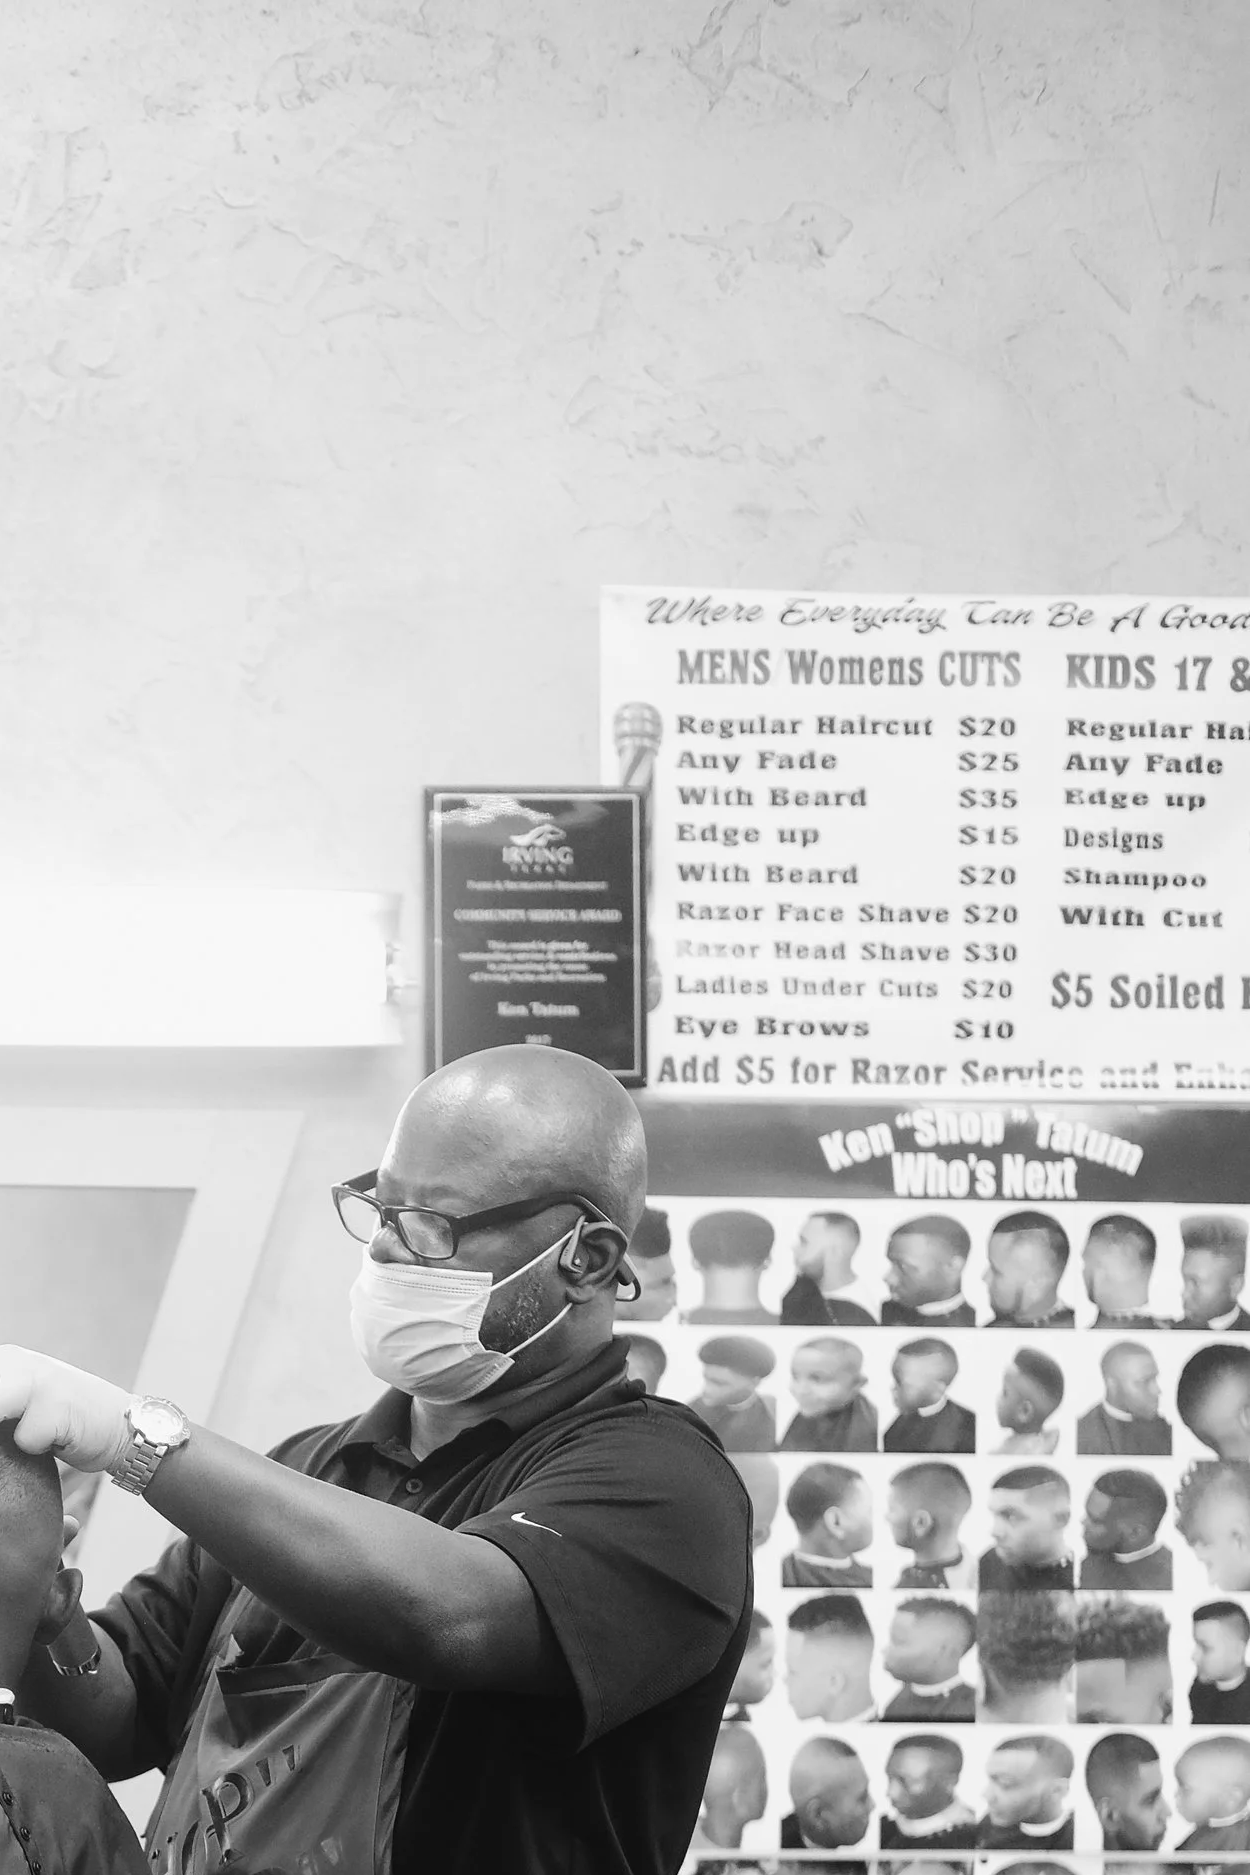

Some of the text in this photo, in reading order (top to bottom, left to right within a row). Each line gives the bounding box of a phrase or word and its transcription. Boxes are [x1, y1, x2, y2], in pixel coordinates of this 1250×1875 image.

[645, 593, 763, 627] Where
[778, 596, 948, 634] Everyday
[1048, 601, 1094, 629] Be
[1110, 603, 1150, 633] A
[675, 649, 1021, 688] MENS Womens CUTS
[1065, 653, 1156, 690] KIDS
[1174, 656, 1213, 692] 17
[676, 713, 803, 739] Regular
[815, 714, 934, 736] Haircut
[1066, 718, 1250, 742] Regular Ha
[676, 750, 742, 774] Any
[756, 751, 838, 770] Fade
[1064, 752, 1224, 777] Any Fade
[677, 785, 755, 807] With
[768, 786, 868, 807] Beard
[1063, 788, 1207, 811] Edge up
[676, 824, 761, 846] Edge
[777, 828, 821, 848] up
[1063, 827, 1164, 853] Designs
[677, 864, 751, 883] With
[765, 864, 859, 885] Beard
[1063, 867, 1208, 891] Shampoo
[677, 902, 764, 922] Razor
[776, 902, 845, 923] Face
[858, 903, 951, 923] Shave
[1060, 906, 1224, 928] With Cut
[774, 941, 847, 961] Head
[860, 942, 951, 961] Shave
[676, 974, 769, 995] Ladies
[782, 976, 867, 997] Under
[879, 978, 939, 998] Cuts
[1051, 970, 1094, 1010] $5
[1110, 973, 1224, 1010] Soiled
[676, 1015, 740, 1038] Eye
[756, 1016, 871, 1037] Brows
[657, 1055, 720, 1083] Add
[736, 1056, 774, 1085] $5
[791, 1057, 837, 1084] for
[852, 1058, 947, 1085] Razor
[818, 1122, 896, 1173] Ken
[1033, 1108, 1144, 1176] Tatum
[891, 1152, 1079, 1200] Who's Next
